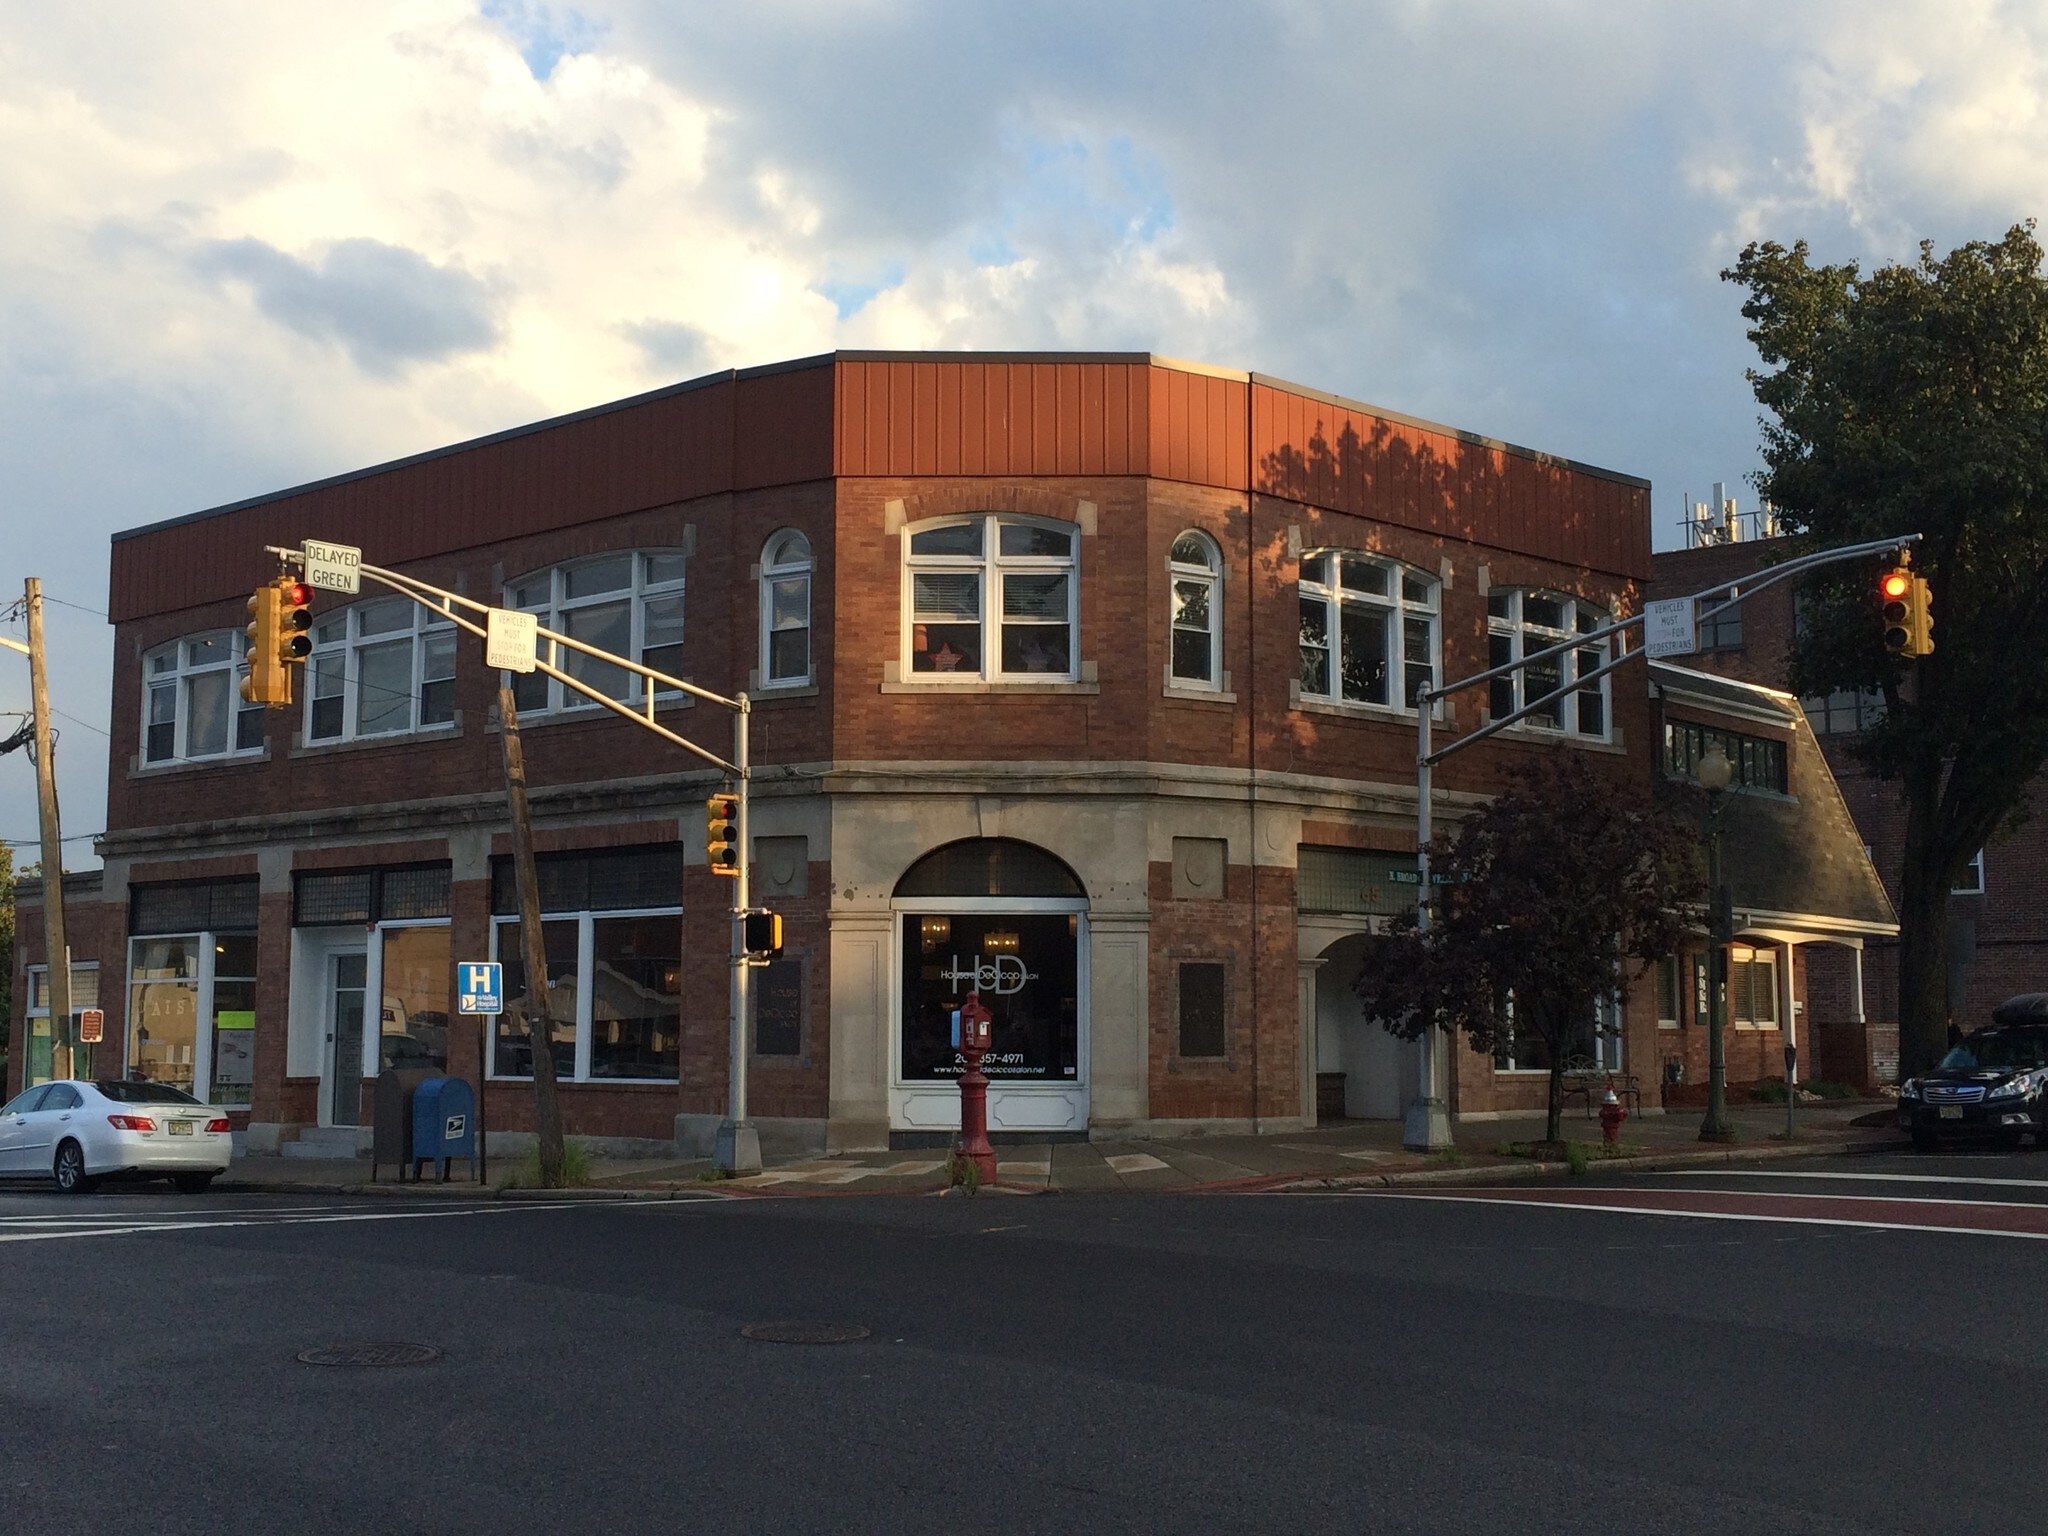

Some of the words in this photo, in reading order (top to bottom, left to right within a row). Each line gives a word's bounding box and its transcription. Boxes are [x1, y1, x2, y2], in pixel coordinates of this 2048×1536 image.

[309, 545, 359, 567] DELAYED
[313, 569, 352, 589] GREEN
[1654, 601, 1685, 614] VEHICLES
[498, 614, 528, 628] VEHICLES
[1661, 614, 1679, 626] MUST
[503, 629, 520, 639] MUST
[1671, 627, 1685, 638] FOR
[514, 643, 527, 654] FOR
[1648, 639, 1692, 653] PEDESTRIANS
[490, 652, 533, 668] PEDESTRIANS
[470, 966, 491, 993] H
